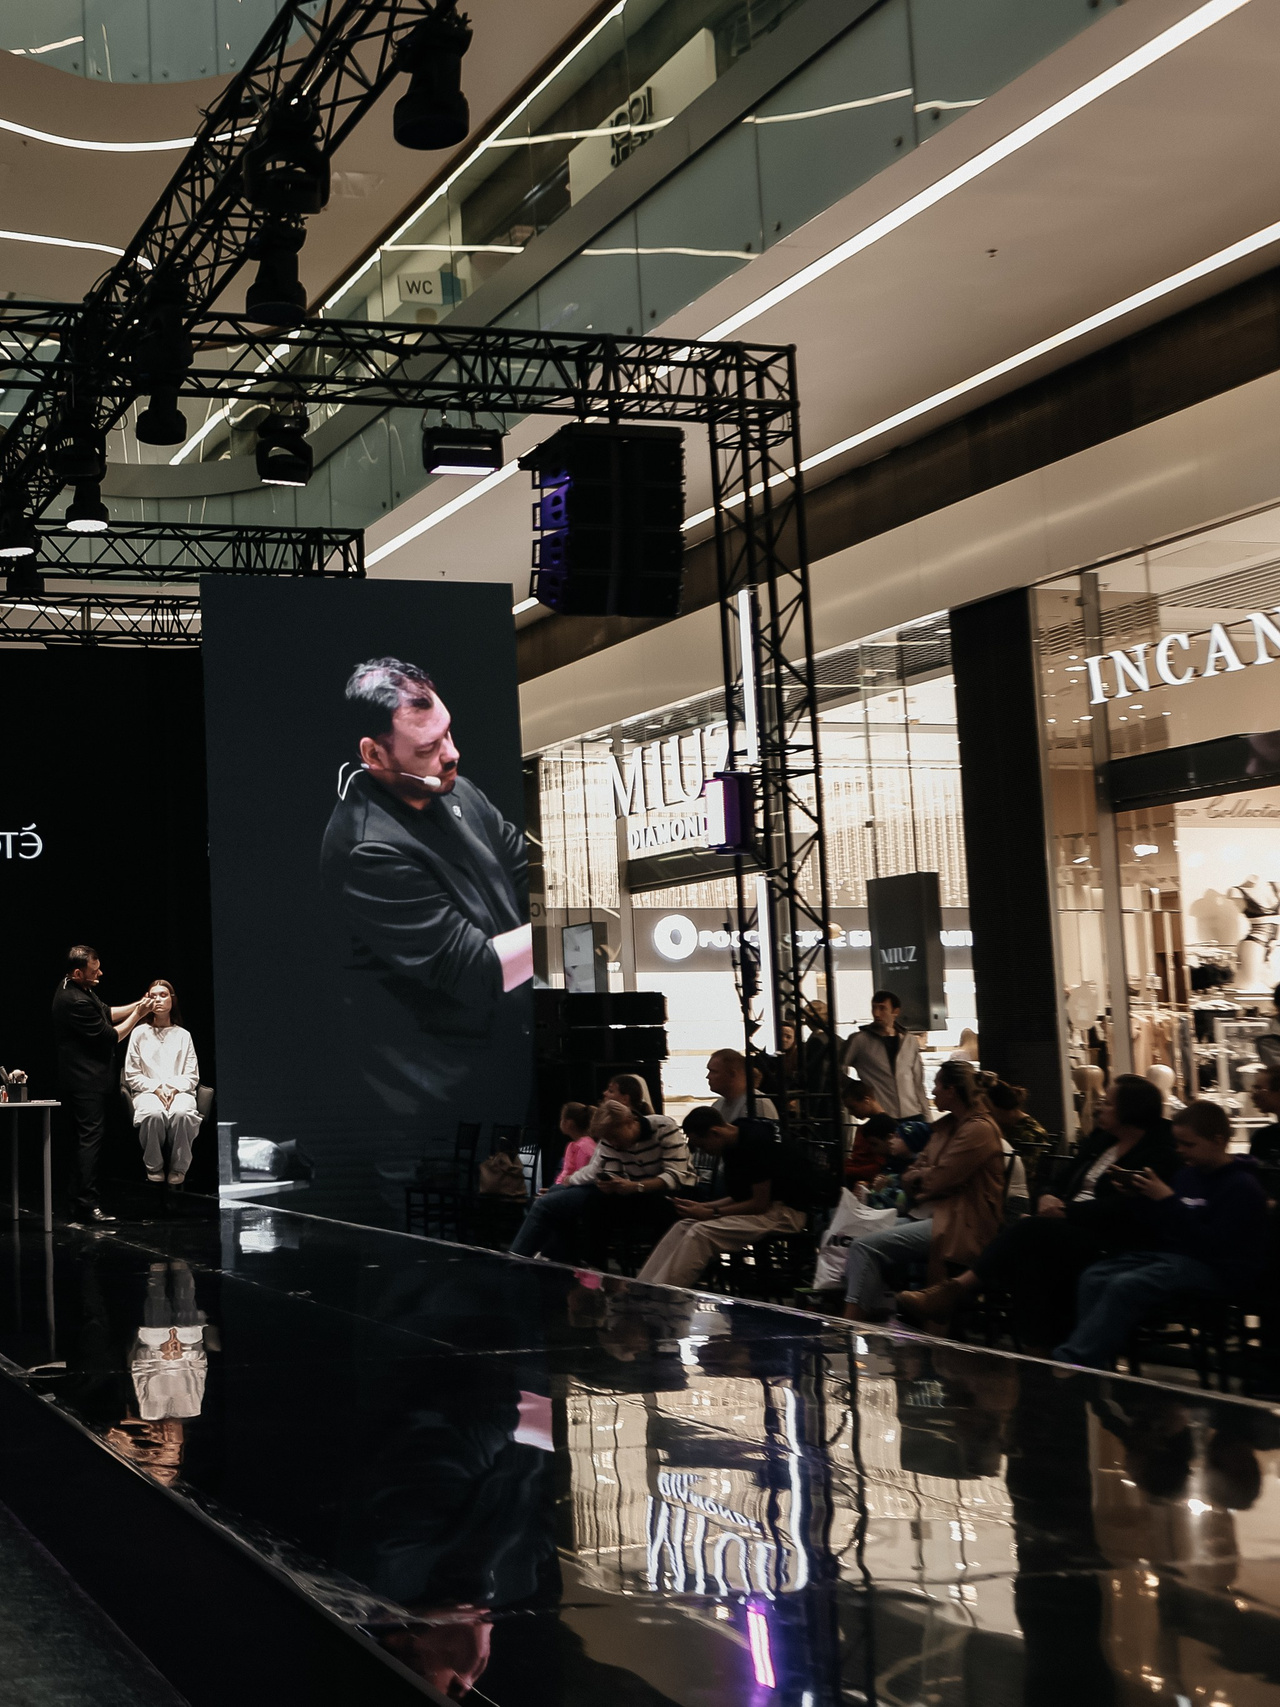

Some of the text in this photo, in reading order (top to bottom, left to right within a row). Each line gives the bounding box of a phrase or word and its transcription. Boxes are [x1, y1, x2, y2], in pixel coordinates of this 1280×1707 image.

[405, 280, 433, 295] WC
[606, 719, 729, 820] MIUZ
[629, 814, 710, 850] DIAMOND
[880, 945, 918, 964] MIUZ
